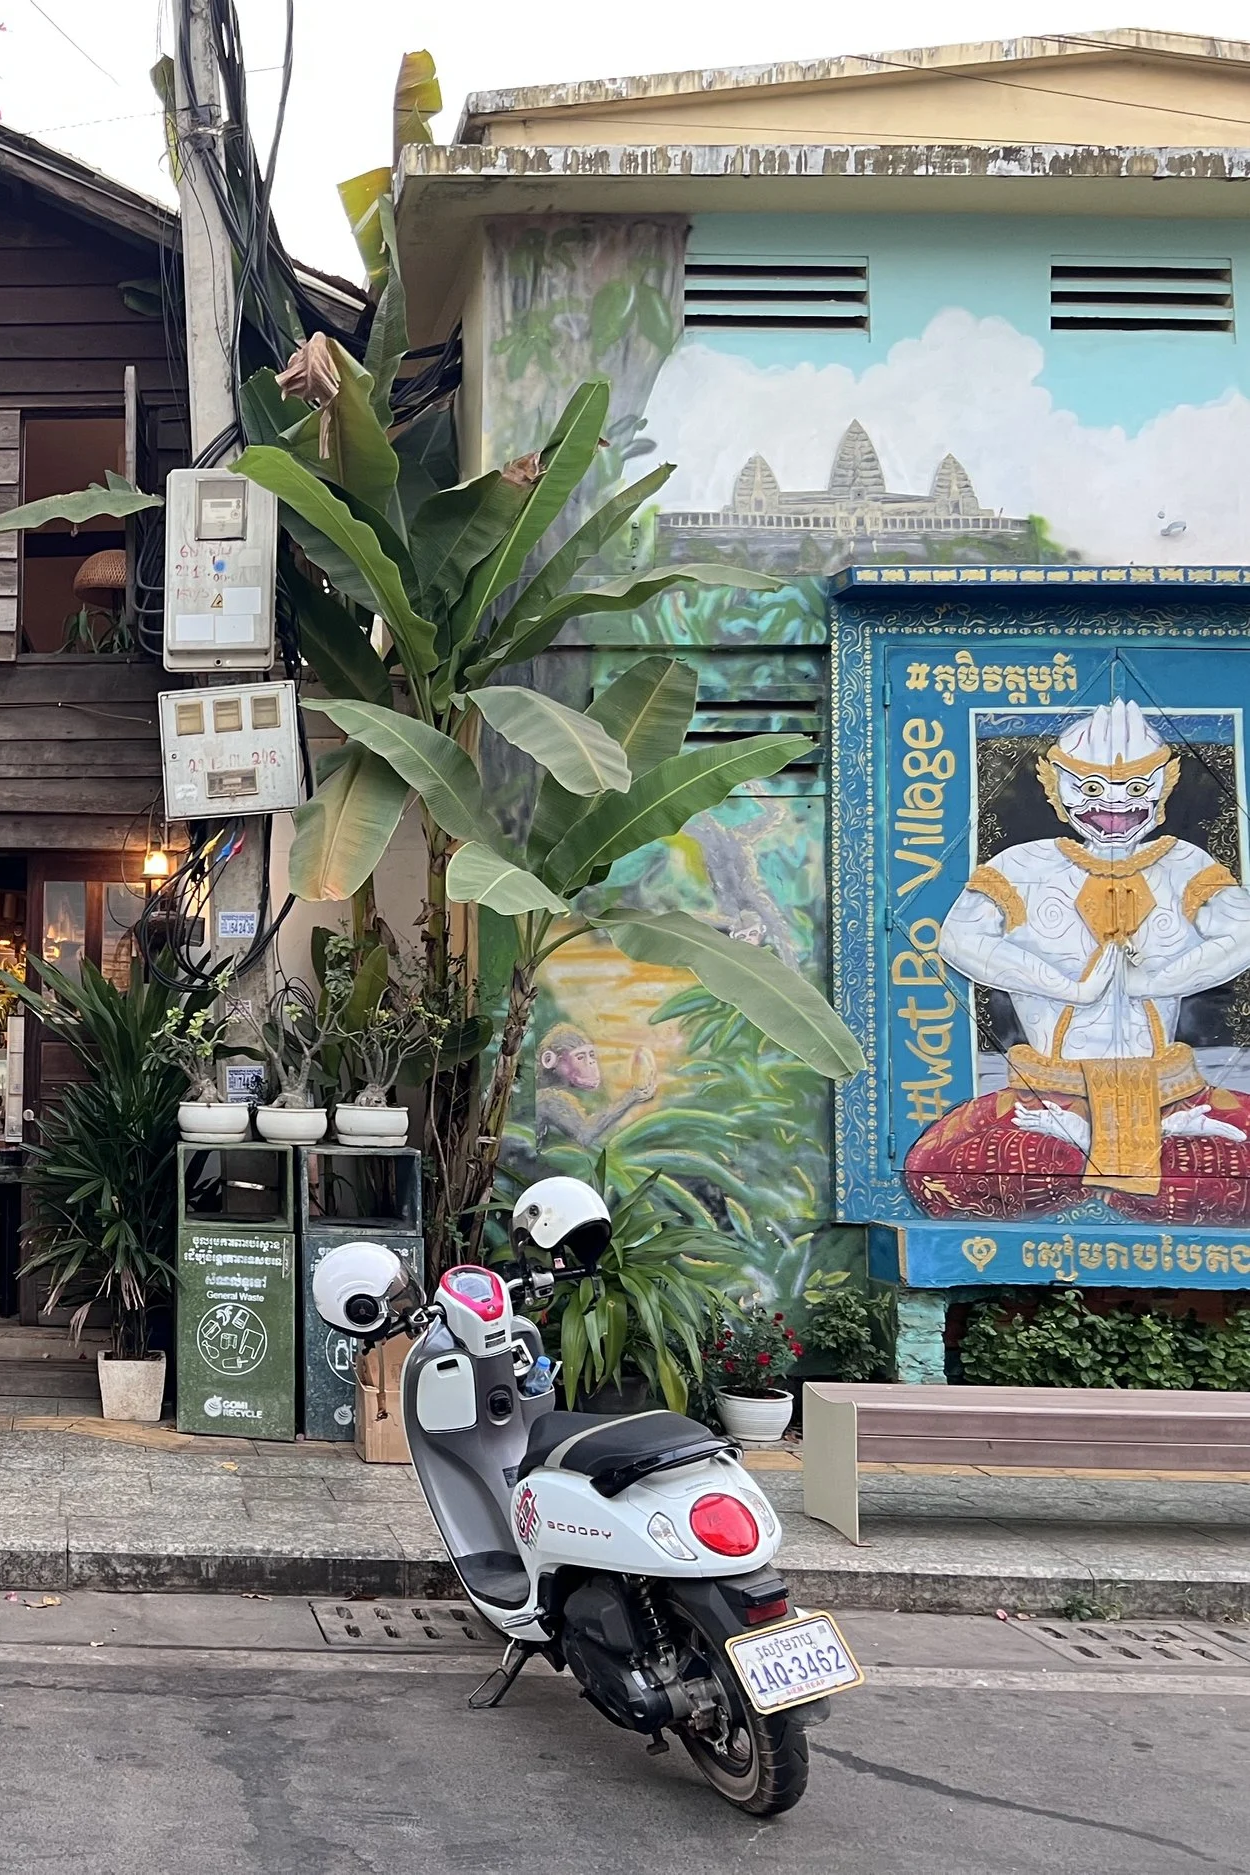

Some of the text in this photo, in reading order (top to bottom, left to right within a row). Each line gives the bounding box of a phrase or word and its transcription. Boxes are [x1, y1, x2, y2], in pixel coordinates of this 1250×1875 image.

[894, 718, 955, 897] Village
[206, 1290, 265, 1302] General Waste
[222, 1400, 248, 1409] GOMI
[222, 1409, 263, 1419] RECYCLE
[547, 1520, 612, 1540] SCOOPY
[786, 1679, 826, 1696] SIEM REAP
